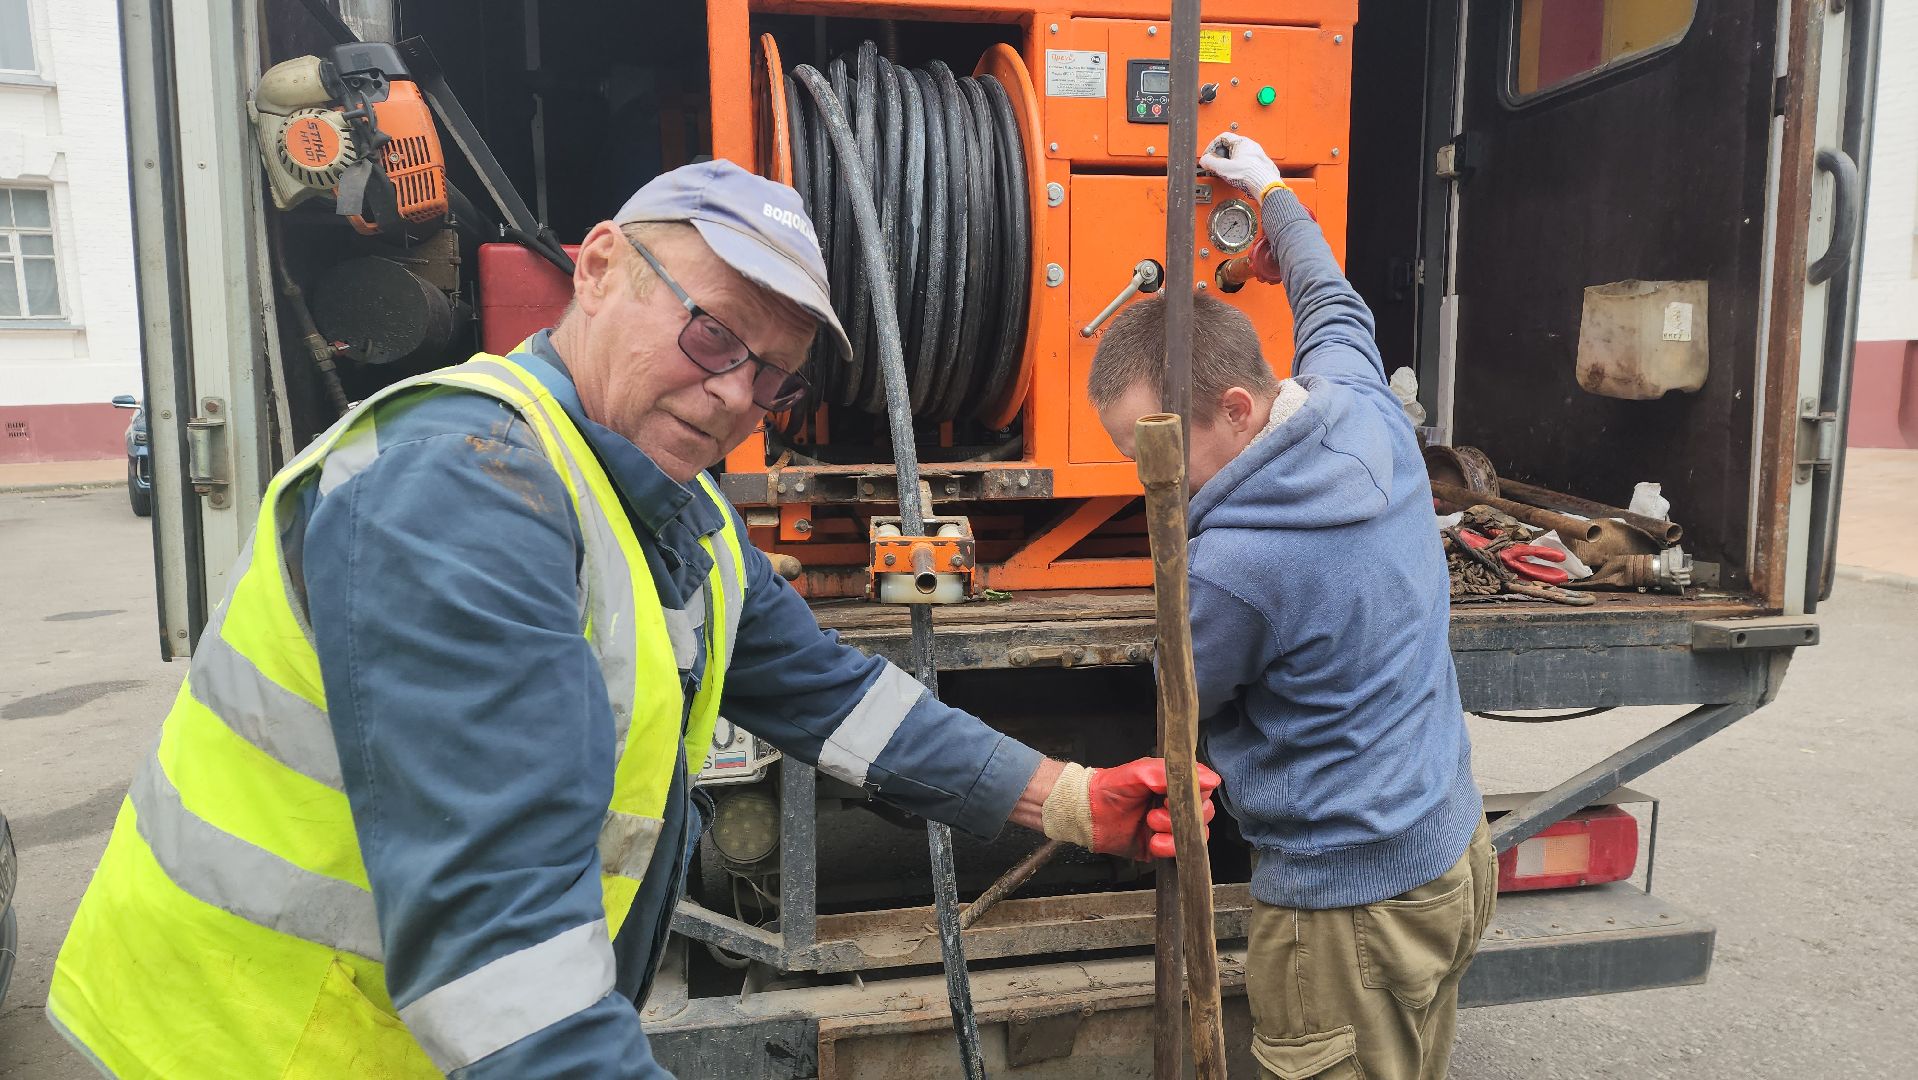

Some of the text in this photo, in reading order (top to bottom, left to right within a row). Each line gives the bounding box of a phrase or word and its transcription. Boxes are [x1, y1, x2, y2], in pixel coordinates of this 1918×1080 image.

[300, 131, 315, 162] HT 101
[306, 121, 327, 163] STIHL
